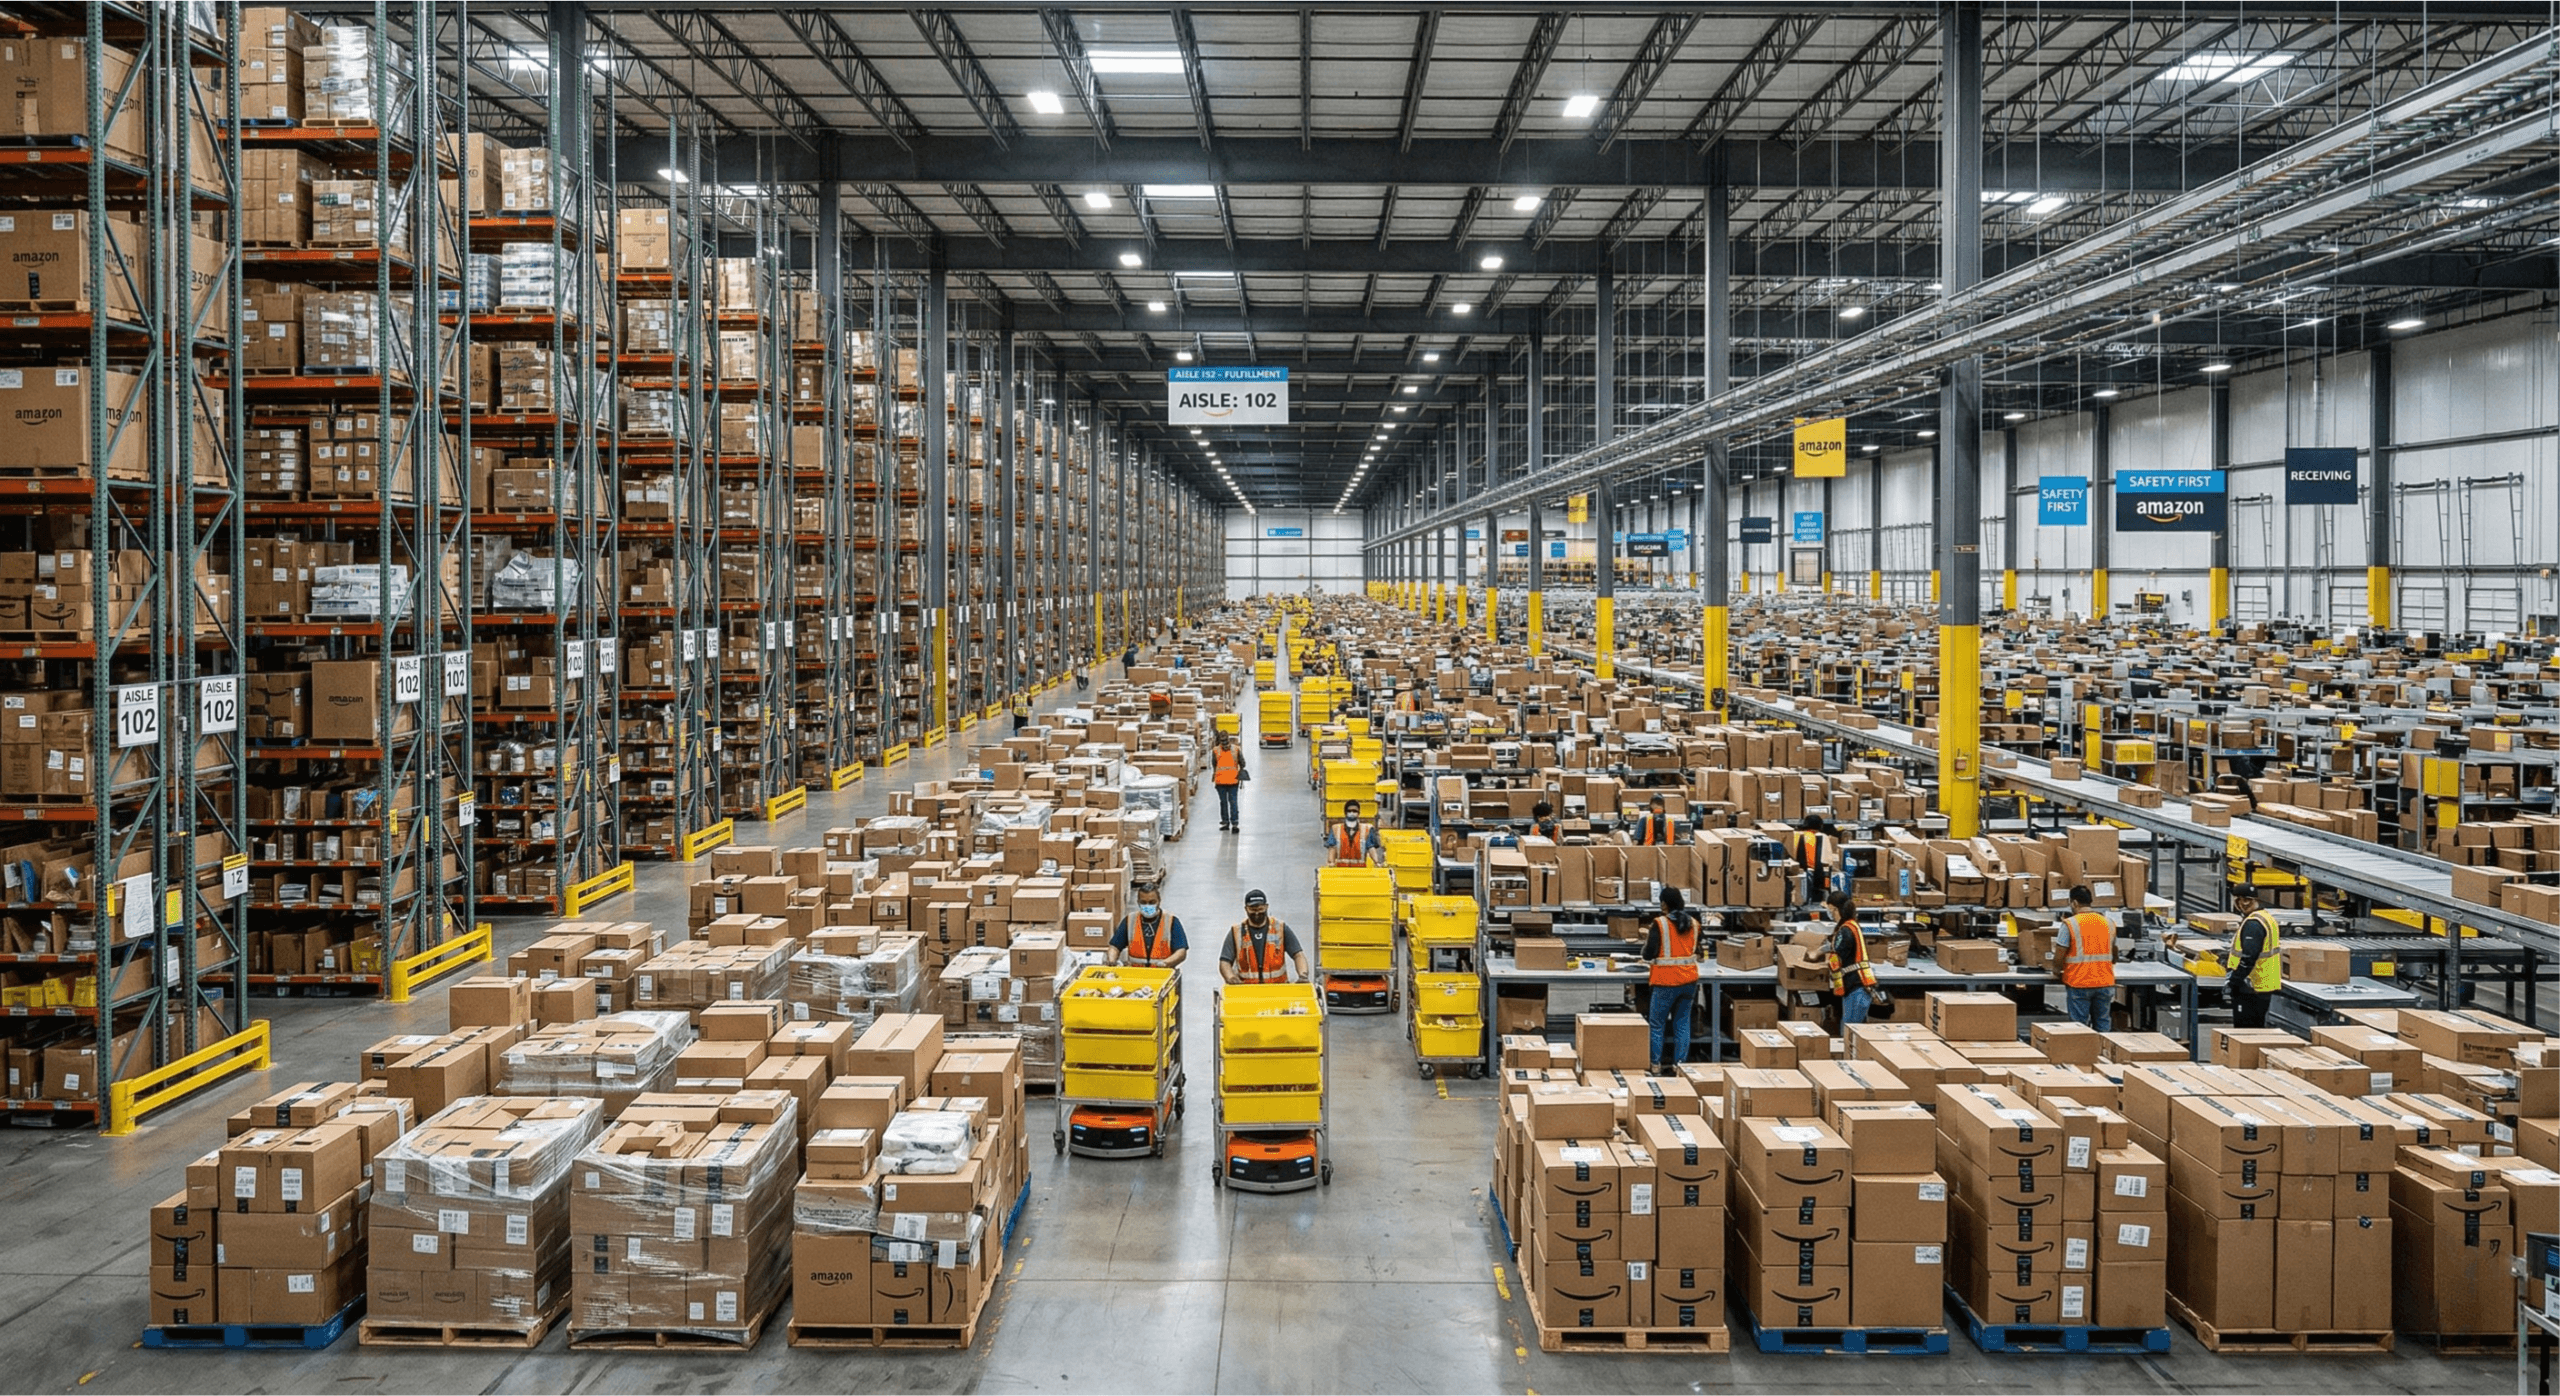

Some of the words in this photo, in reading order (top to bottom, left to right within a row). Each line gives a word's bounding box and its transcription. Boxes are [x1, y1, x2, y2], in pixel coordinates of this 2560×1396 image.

[12, 251, 60, 262] amazon
[1179, 393, 1238, 408] AISLE:
[1245, 392, 1277, 408] 102
[15, 408, 62, 419] amazon
[1798, 441, 1842, 451] amazon
[2290, 470, 2352, 481] RECEIVING
[2129, 476, 2175, 488] SAFETY
[2177, 476, 2211, 488] FIRST
[2041, 489, 2084, 500] SAFETY
[2046, 501, 2080, 513] FIRST
[2136, 501, 2205, 514] amazon
[398, 675, 419, 694] 102
[446, 669, 465, 688] 102
[205, 681, 233, 694] AISLE
[124, 688, 154, 703] AISLE
[203, 699, 235, 723] 102
[120, 708, 156, 735] 102
[810, 1272, 853, 1281] amazon
